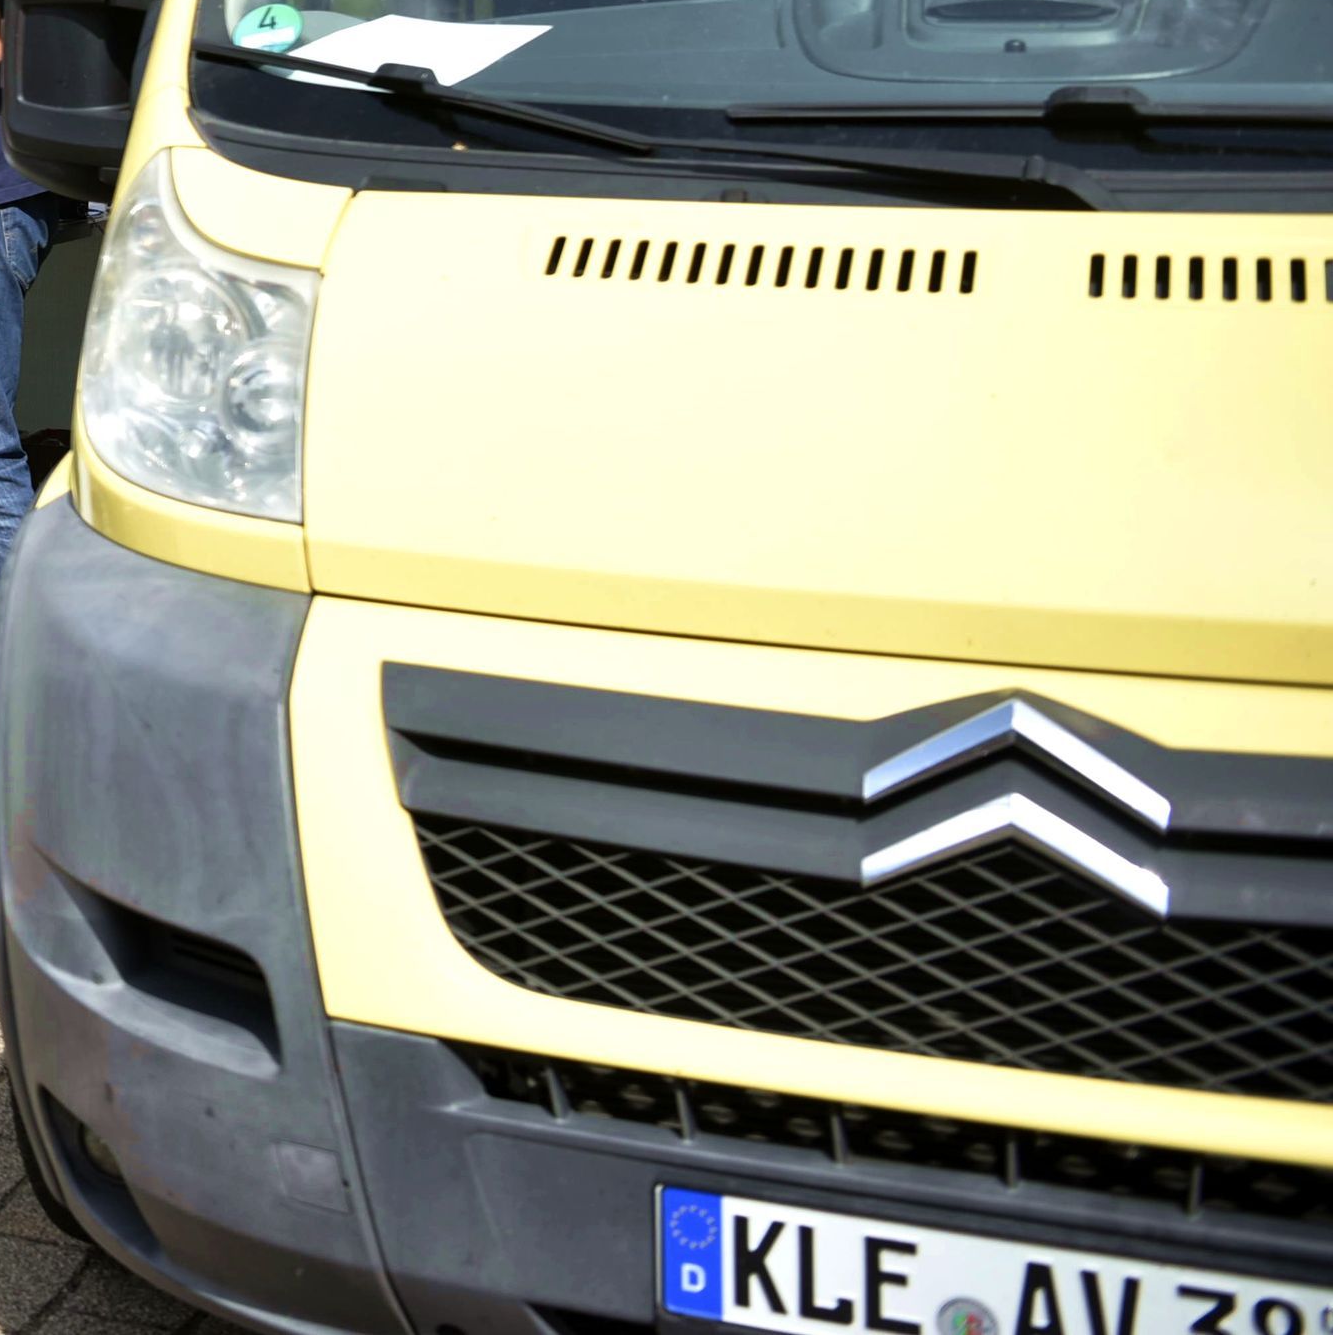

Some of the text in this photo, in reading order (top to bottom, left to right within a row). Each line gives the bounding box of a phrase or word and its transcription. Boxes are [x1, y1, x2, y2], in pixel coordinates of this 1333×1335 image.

[257, 7, 277, 30] 4
[681, 1262, 706, 1293] D
[733, 1214, 922, 1335] KLE
[1014, 1261, 1142, 1335] AV
